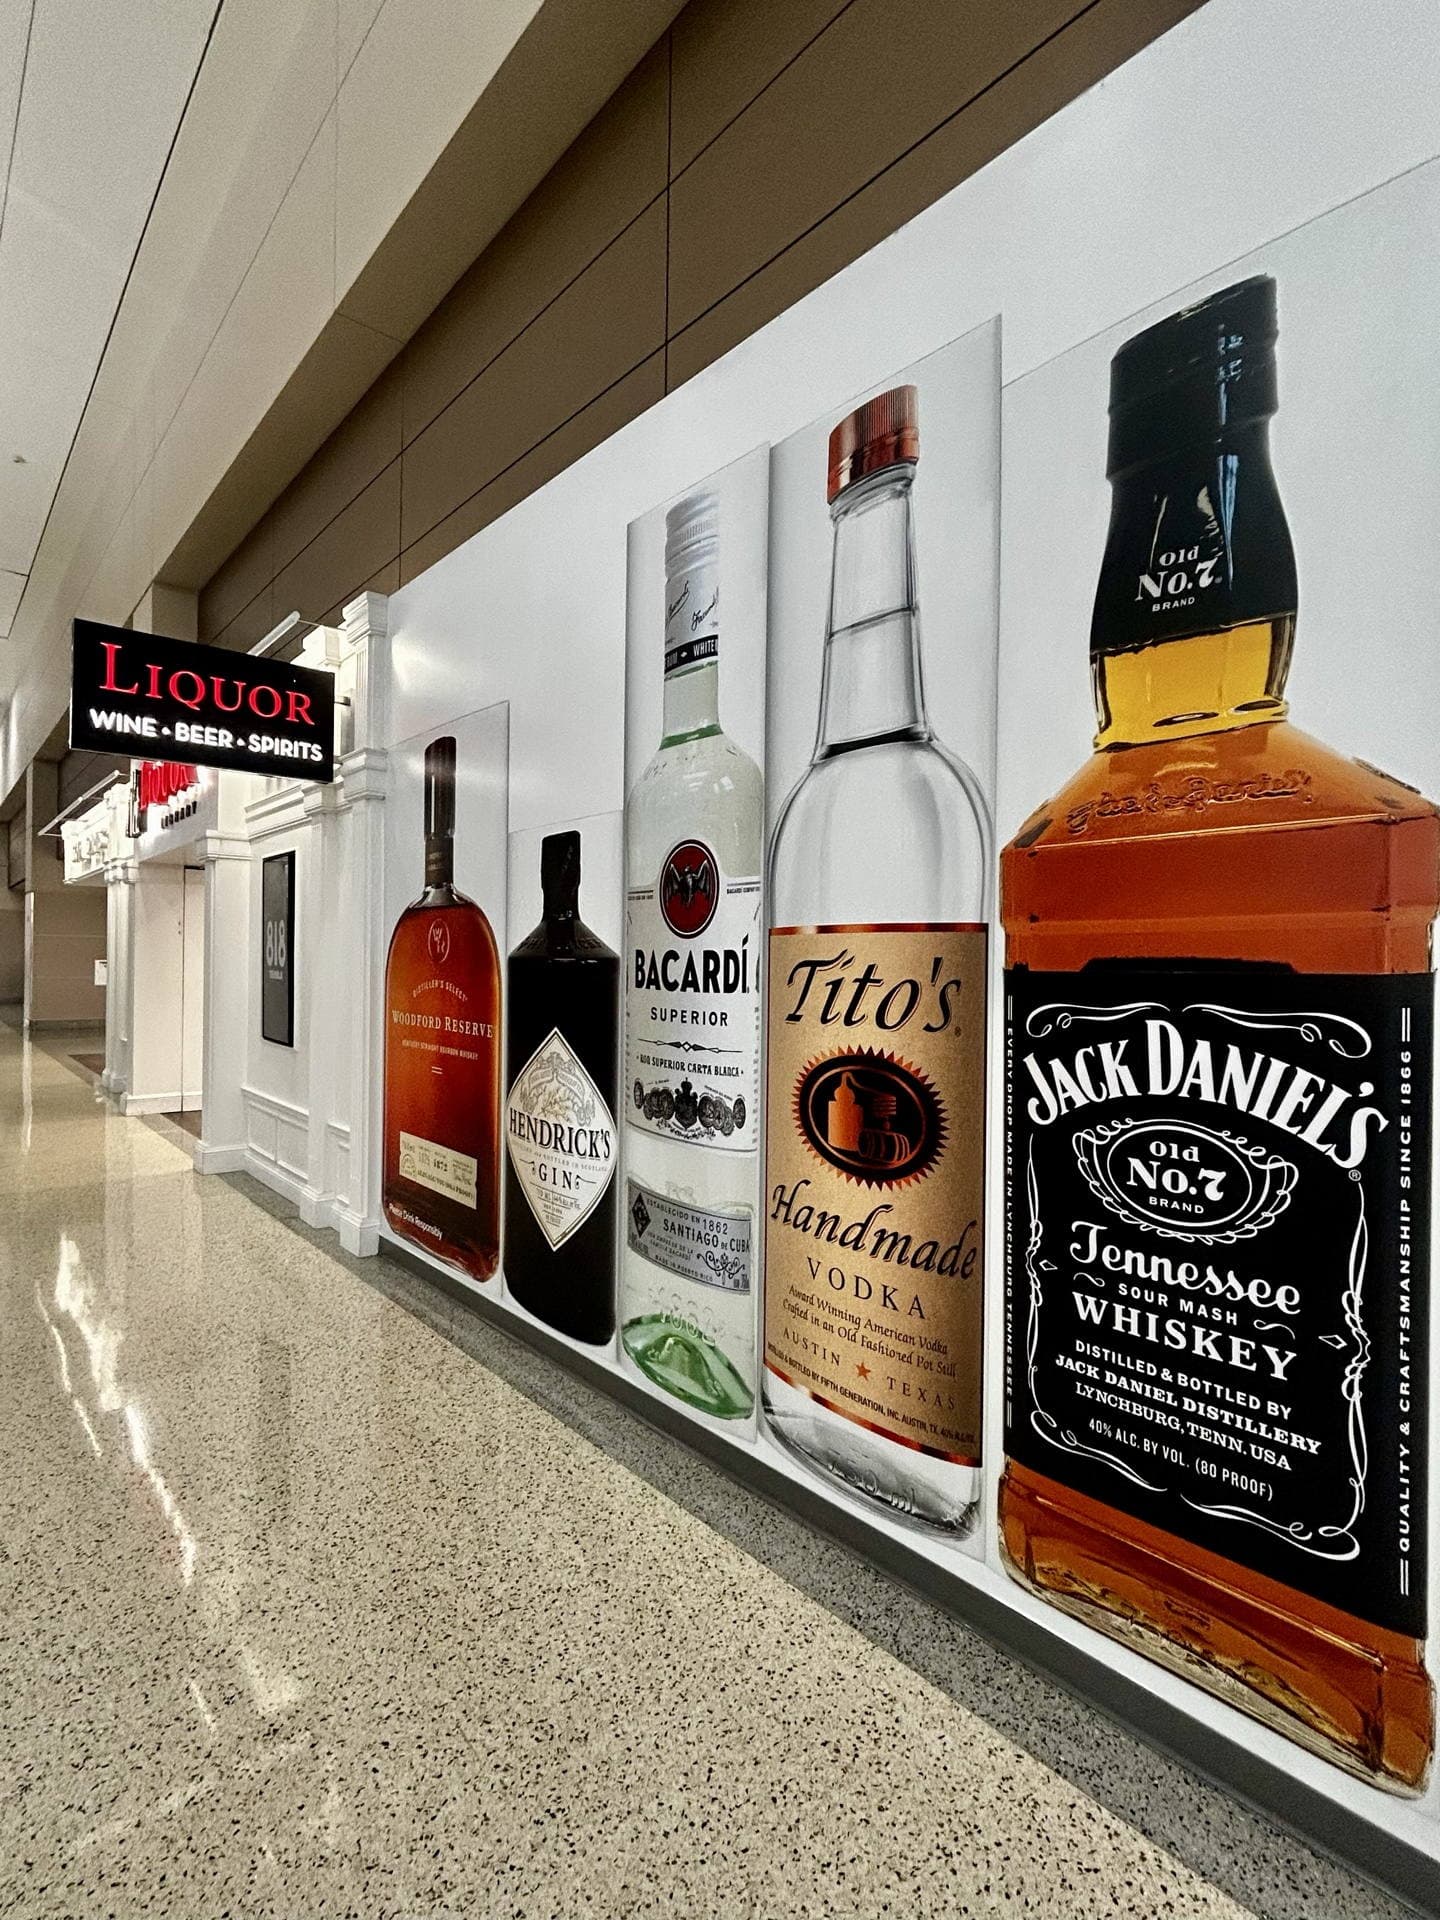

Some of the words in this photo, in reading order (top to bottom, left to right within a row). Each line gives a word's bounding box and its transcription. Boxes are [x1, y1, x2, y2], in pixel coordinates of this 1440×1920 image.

[1159, 545, 1200, 567] Old
[1152, 597, 1196, 612] BRAND
[99, 641, 316, 726] LIQUOR
[89, 707, 158, 738] WINE
[175, 721, 234, 749] BEER
[248, 733, 324, 762] SPIRITS
[266, 919, 287, 968] 818
[635, 933, 749, 994] BACARDÍ
[650, 1006, 729, 1027] SUPERIOR
[784, 948, 962, 1034] Tito's
[392, 1009, 442, 1030] WOODFORD
[444, 1016, 494, 1038] RESERVE
[652, 1056, 686, 1071] SUPERIOR
[687, 1062, 713, 1076] CARTA
[1006, 1027, 1014, 1080] EVERY
[1400, 1050, 1412, 1105] 1866
[1006, 1083, 1014, 1126] DROP
[1022, 1038, 1142, 1126] JACK
[1143, 1018, 1390, 1169] DANIEL'S
[508, 1106, 611, 1160] HENDRICK'S
[1006, 1131, 1014, 1177] MADE
[1148, 1140, 1201, 1163] Old
[1400, 1114, 1412, 1189] SINCE
[538, 1163, 573, 1191] GIN
[1006, 1180, 1014, 1198] IN
[646, 1198, 689, 1220] ESTABLECIDO
[691, 1215, 701, 1224] EN
[702, 1218, 728, 1236] 1862
[770, 1178, 978, 1280] Handmade
[1148, 1195, 1205, 1215] BRAND
[663, 1218, 720, 1248] SANTIAGO
[806, 1256, 926, 1320] VODKA
[1069, 1220, 1301, 1315] Tennessee
[788, 1284, 815, 1306] Award
[816, 1298, 862, 1330] Winning
[864, 1318, 916, 1346] American
[918, 1335, 948, 1355] Vodka
[1118, 1282, 1169, 1307] SOUR
[1179, 1298, 1238, 1326] MASH
[1399, 1198, 1411, 1413] CRAFTSMANSHIP
[782, 1298, 809, 1320] Crafted
[810, 1314, 820, 1327] in
[822, 1321, 834, 1334] an
[837, 1325, 857, 1343] Old
[860, 1334, 914, 1365] Fashioned
[916, 1355, 934, 1372] Pot
[936, 1361, 957, 1378] Still
[1072, 1290, 1297, 1382] WHISKEY
[782, 1327, 841, 1367] AUSTIN
[886, 1375, 955, 1410] TEXAS
[788, 1357, 812, 1378] BOTTLED
[811, 1370, 821, 1382] BY
[820, 1375, 839, 1393] FIFTH
[839, 1386, 886, 1416] GENERATION,
[886, 1408, 901, 1422] INC.
[901, 1414, 929, 1434] AUSTIN,
[1075, 1339, 1158, 1376] DISTILLED
[1160, 1367, 1174, 1383] &
[1177, 1372, 1261, 1410] BOTTLED
[1266, 1400, 1292, 1420] BY
[1055, 1353, 1100, 1380] JACK
[1104, 1370, 1178, 1407] DANIEL
[1182, 1396, 1322, 1455] DISTILLERY
[1075, 1381, 1185, 1435] LYNCHBURG,
[1186, 1421, 1248, 1455] TENN.
[1249, 1443, 1293, 1471] USA
[1399, 1422, 1411, 1436] &
[1088, 1417, 1112, 1438] 40%
[1115, 1427, 1140, 1449] ALC.
[1143, 1438, 1159, 1456] BY
[1162, 1446, 1191, 1468] VOL.
[1195, 1456, 1217, 1478] (80
[1222, 1467, 1273, 1502] PROOF)
[1399, 1443, 1411, 1552] QUALITY
